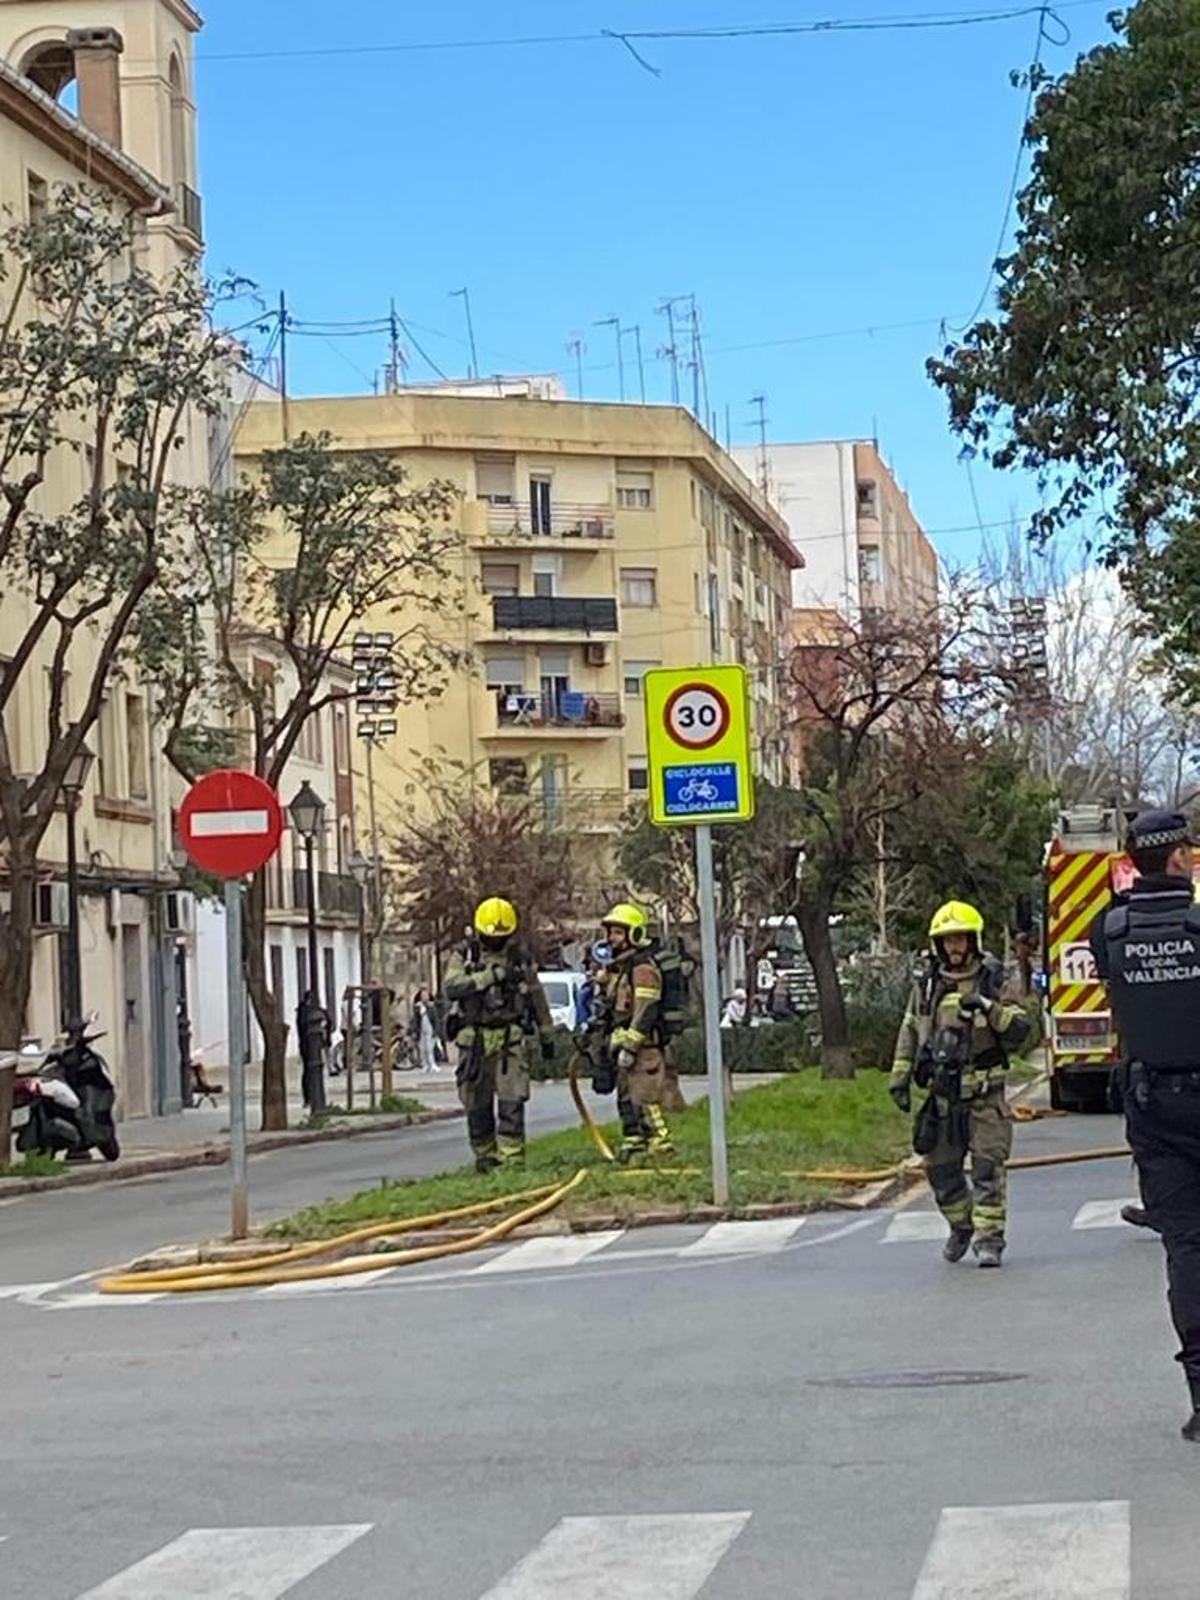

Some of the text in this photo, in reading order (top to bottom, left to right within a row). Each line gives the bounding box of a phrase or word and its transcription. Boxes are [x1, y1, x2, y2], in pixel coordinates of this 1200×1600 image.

[678, 705, 716, 727] 30
[1125, 940, 1195, 957] POLICIA
[1066, 961, 1099, 979] 112
[1141, 957, 1179, 968] LOCAL
